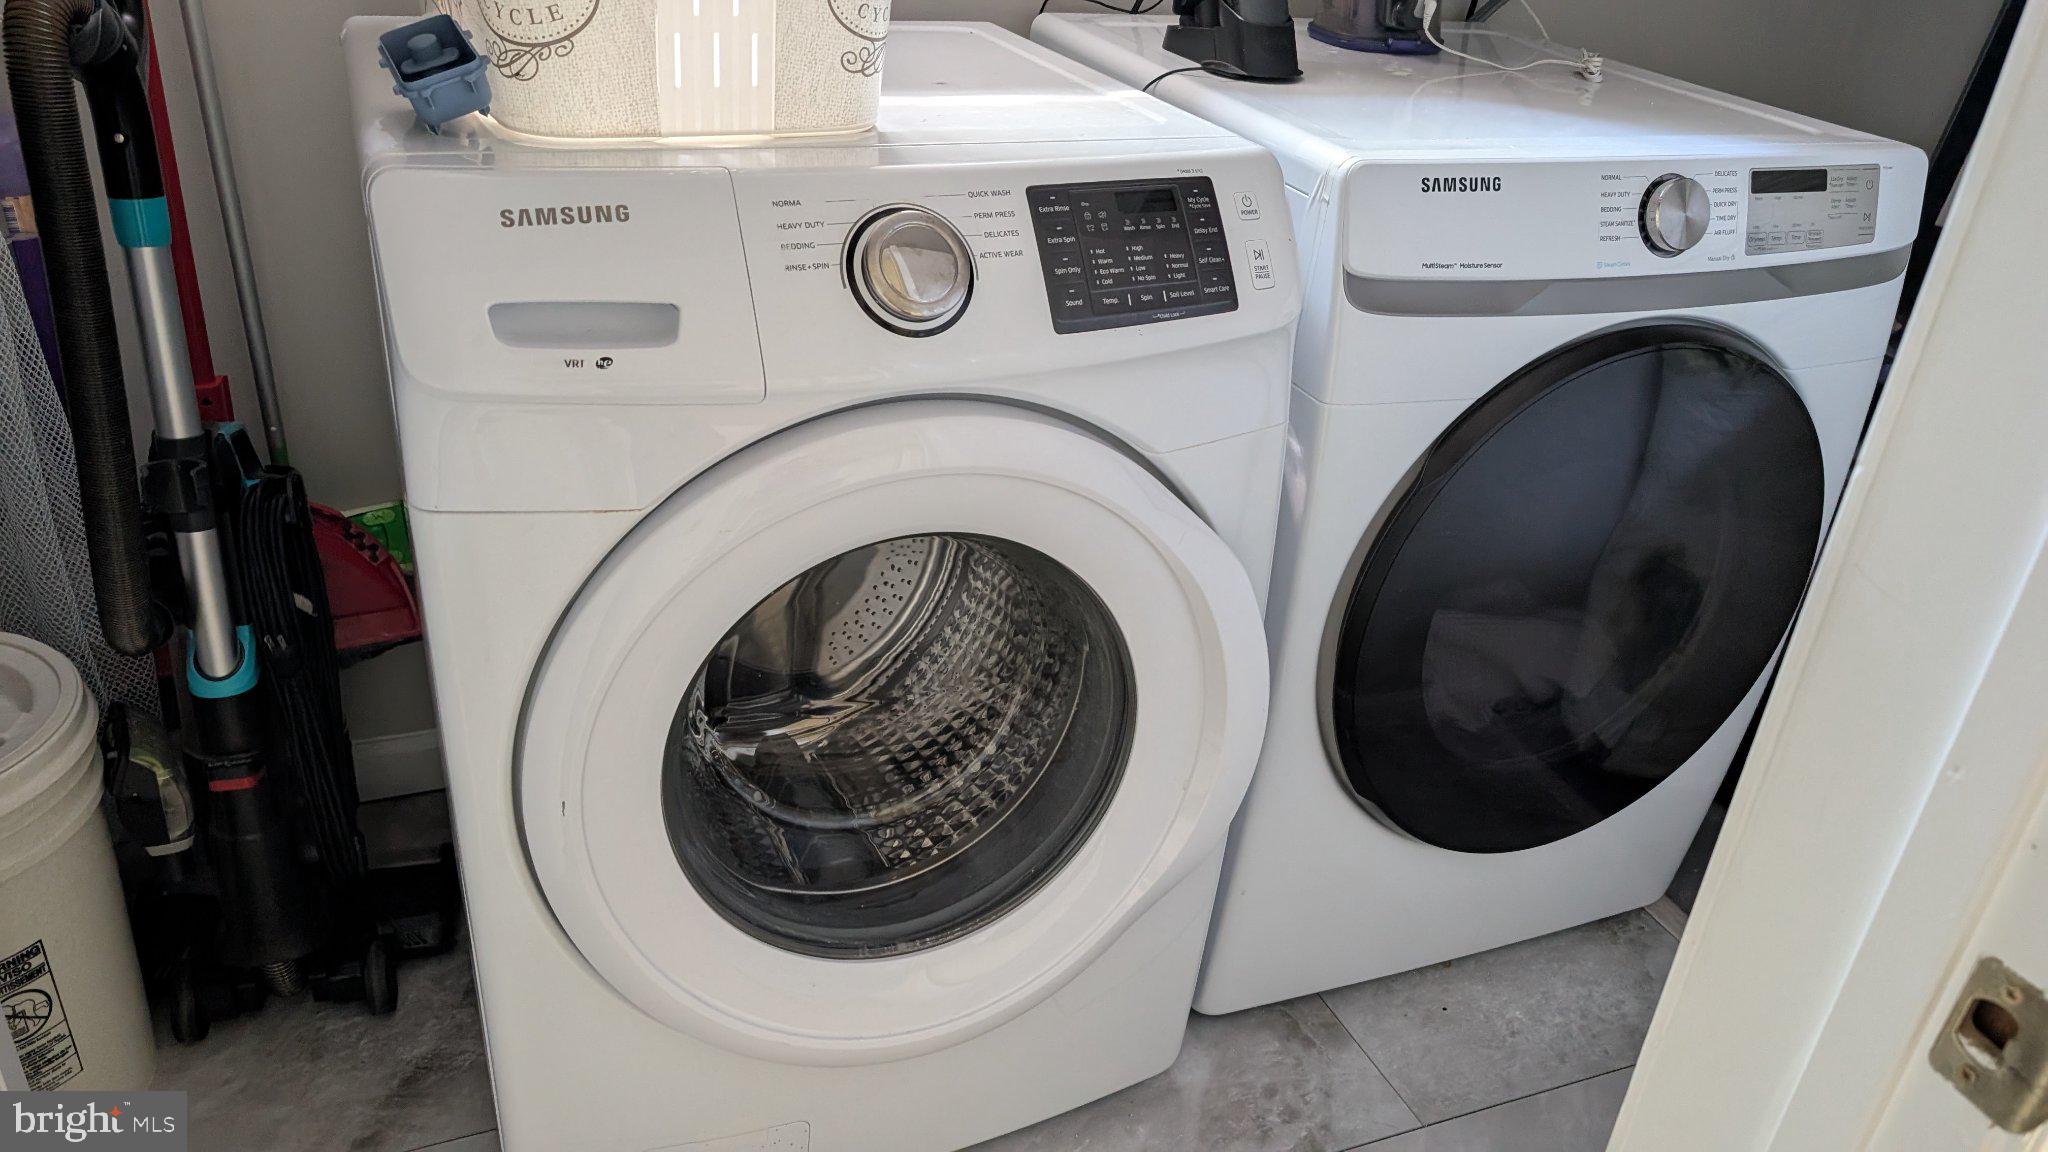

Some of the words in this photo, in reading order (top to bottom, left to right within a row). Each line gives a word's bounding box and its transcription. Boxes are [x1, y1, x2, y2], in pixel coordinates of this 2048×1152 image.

[1421, 176, 1502, 193] SAMSUNG
[968, 190, 989, 198] QUICK
[991, 189, 1011, 197] WASH
[500, 204, 630, 228] SAMSUNG
[984, 230, 1020, 238] DELICATES
[979, 251, 1000, 259] ACTIVE
[1002, 250, 1024, 258] WEAR
